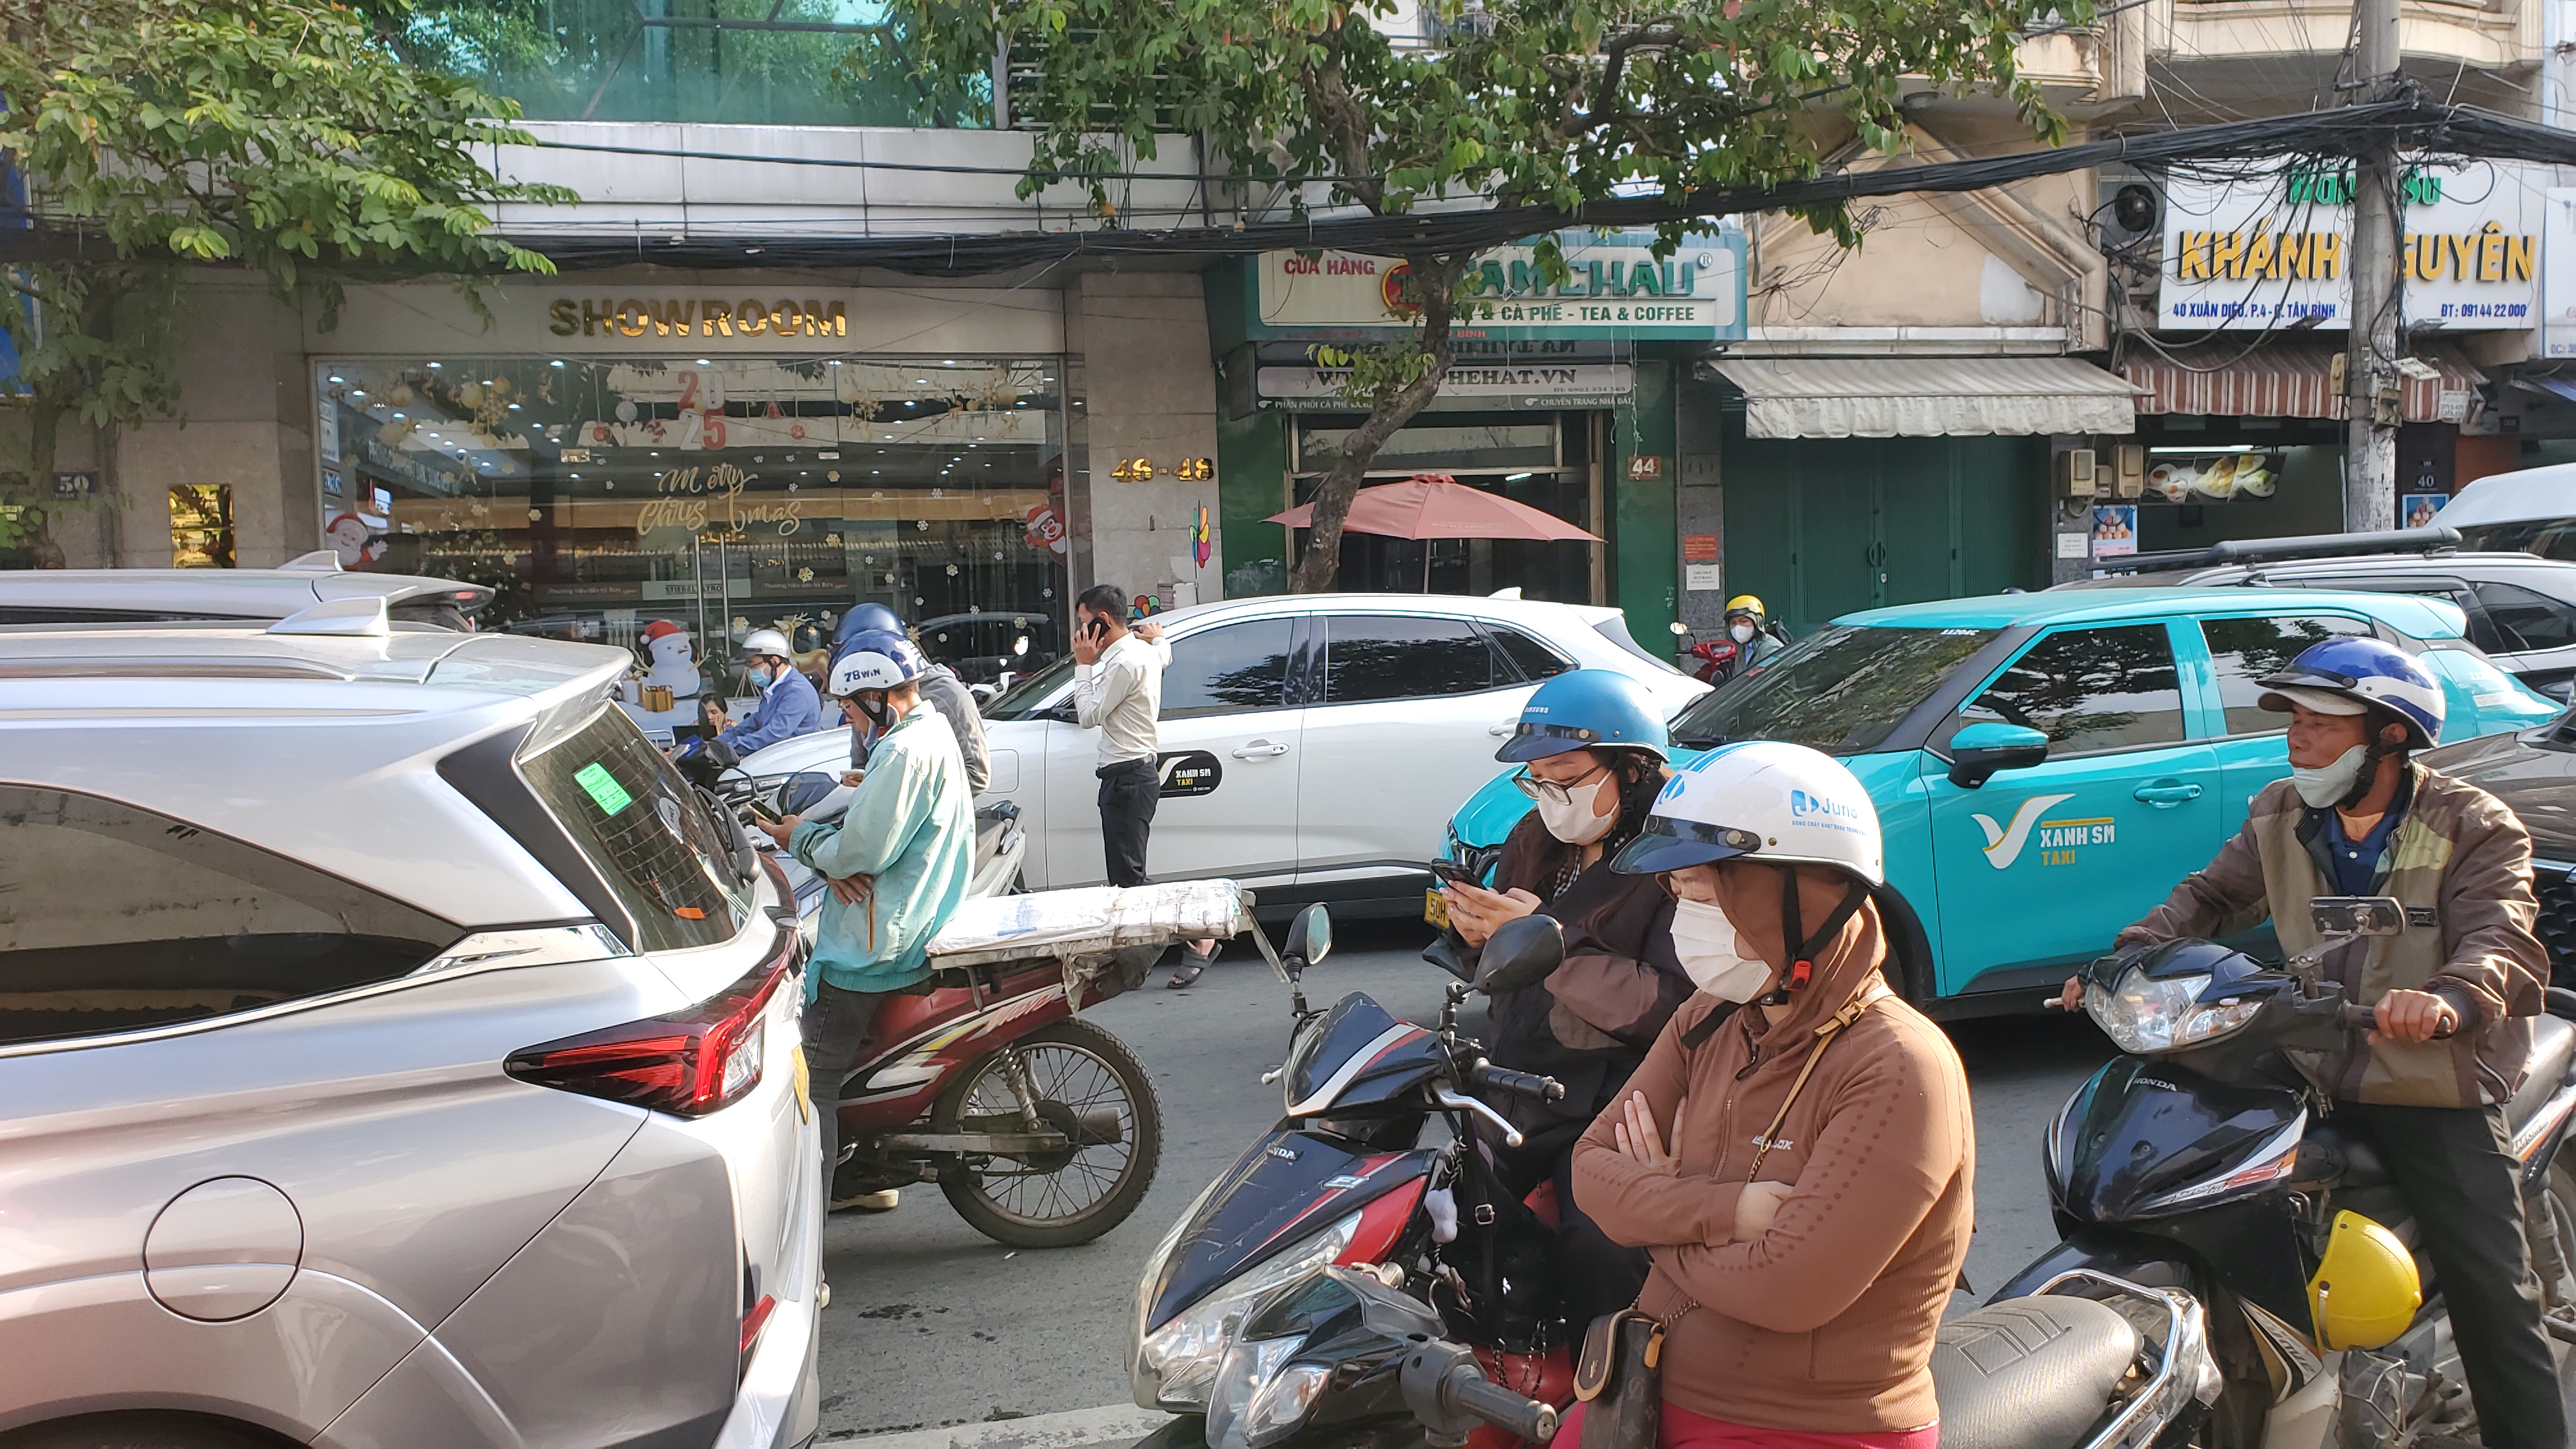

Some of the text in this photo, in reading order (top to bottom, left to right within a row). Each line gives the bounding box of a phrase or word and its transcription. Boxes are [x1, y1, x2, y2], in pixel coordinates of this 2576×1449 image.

[2179, 218, 2536, 282] KHÁNH GUYÊN
[1328, 256, 1375, 275] HÀNG
[549, 298, 847, 337] SHOWROOM
[1502, 303, 1524, 321] CÀ
[1580, 307, 1611, 321] TEA
[1617, 307, 1629, 321] &
[1635, 307, 1695, 321] COFFEE
[2173, 303, 2187, 318] 40
[2189, 301, 2219, 318] XUÂN
[2251, 303, 2267, 318] P.4
[2287, 301, 2308, 318] TÂN
[2494, 303, 2506, 317] 22
[2508, 303, 2527, 317] 000
[1632, 458, 1656, 473] 44
[59, 476, 89, 492] 50
[2418, 475, 2435, 487] 40
[1176, 778, 1193, 786] TAXI
[2040, 824, 2115, 848] XANH SM
[2041, 849, 2075, 866] TAXI
[2133, 1077, 2178, 1092] HONDA
